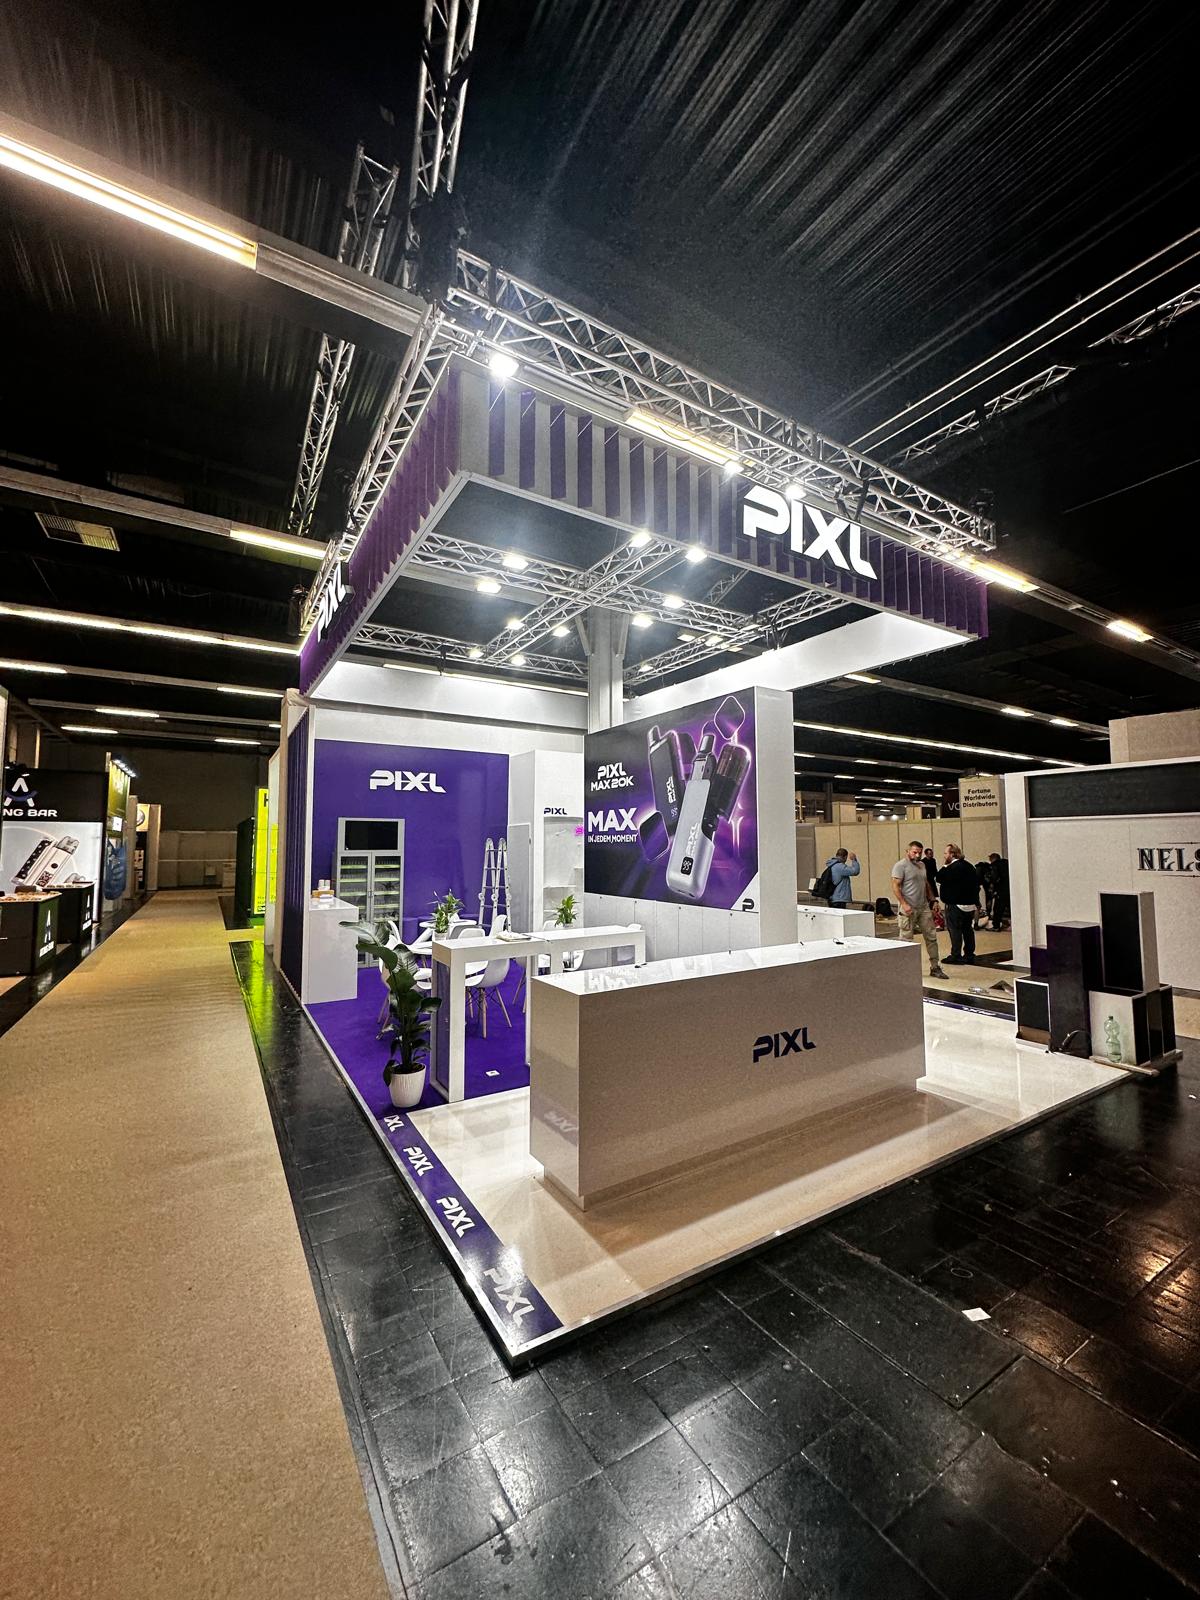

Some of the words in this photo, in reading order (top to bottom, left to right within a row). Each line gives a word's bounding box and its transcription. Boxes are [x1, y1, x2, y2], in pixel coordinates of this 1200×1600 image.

[743, 484, 877, 580] PIXL
[369, 769, 446, 794] PIXL
[597, 762, 627, 780] PIXL
[962, 800, 998, 808] Distributors
[963, 794, 996, 802] Worldwide
[27, 808, 58, 818] BAR
[543, 807, 568, 815] PIXL
[588, 808, 638, 832] MAX
[587, 834, 594, 843] IN
[594, 834, 612, 844] JEDEM
[612, 832, 638, 844] MOMENT
[753, 1027, 816, 1063] PIXL
[403, 1146, 434, 1177] PIXL
[436, 1195, 477, 1239] PIXL
[484, 1268, 535, 1326] PIXL
